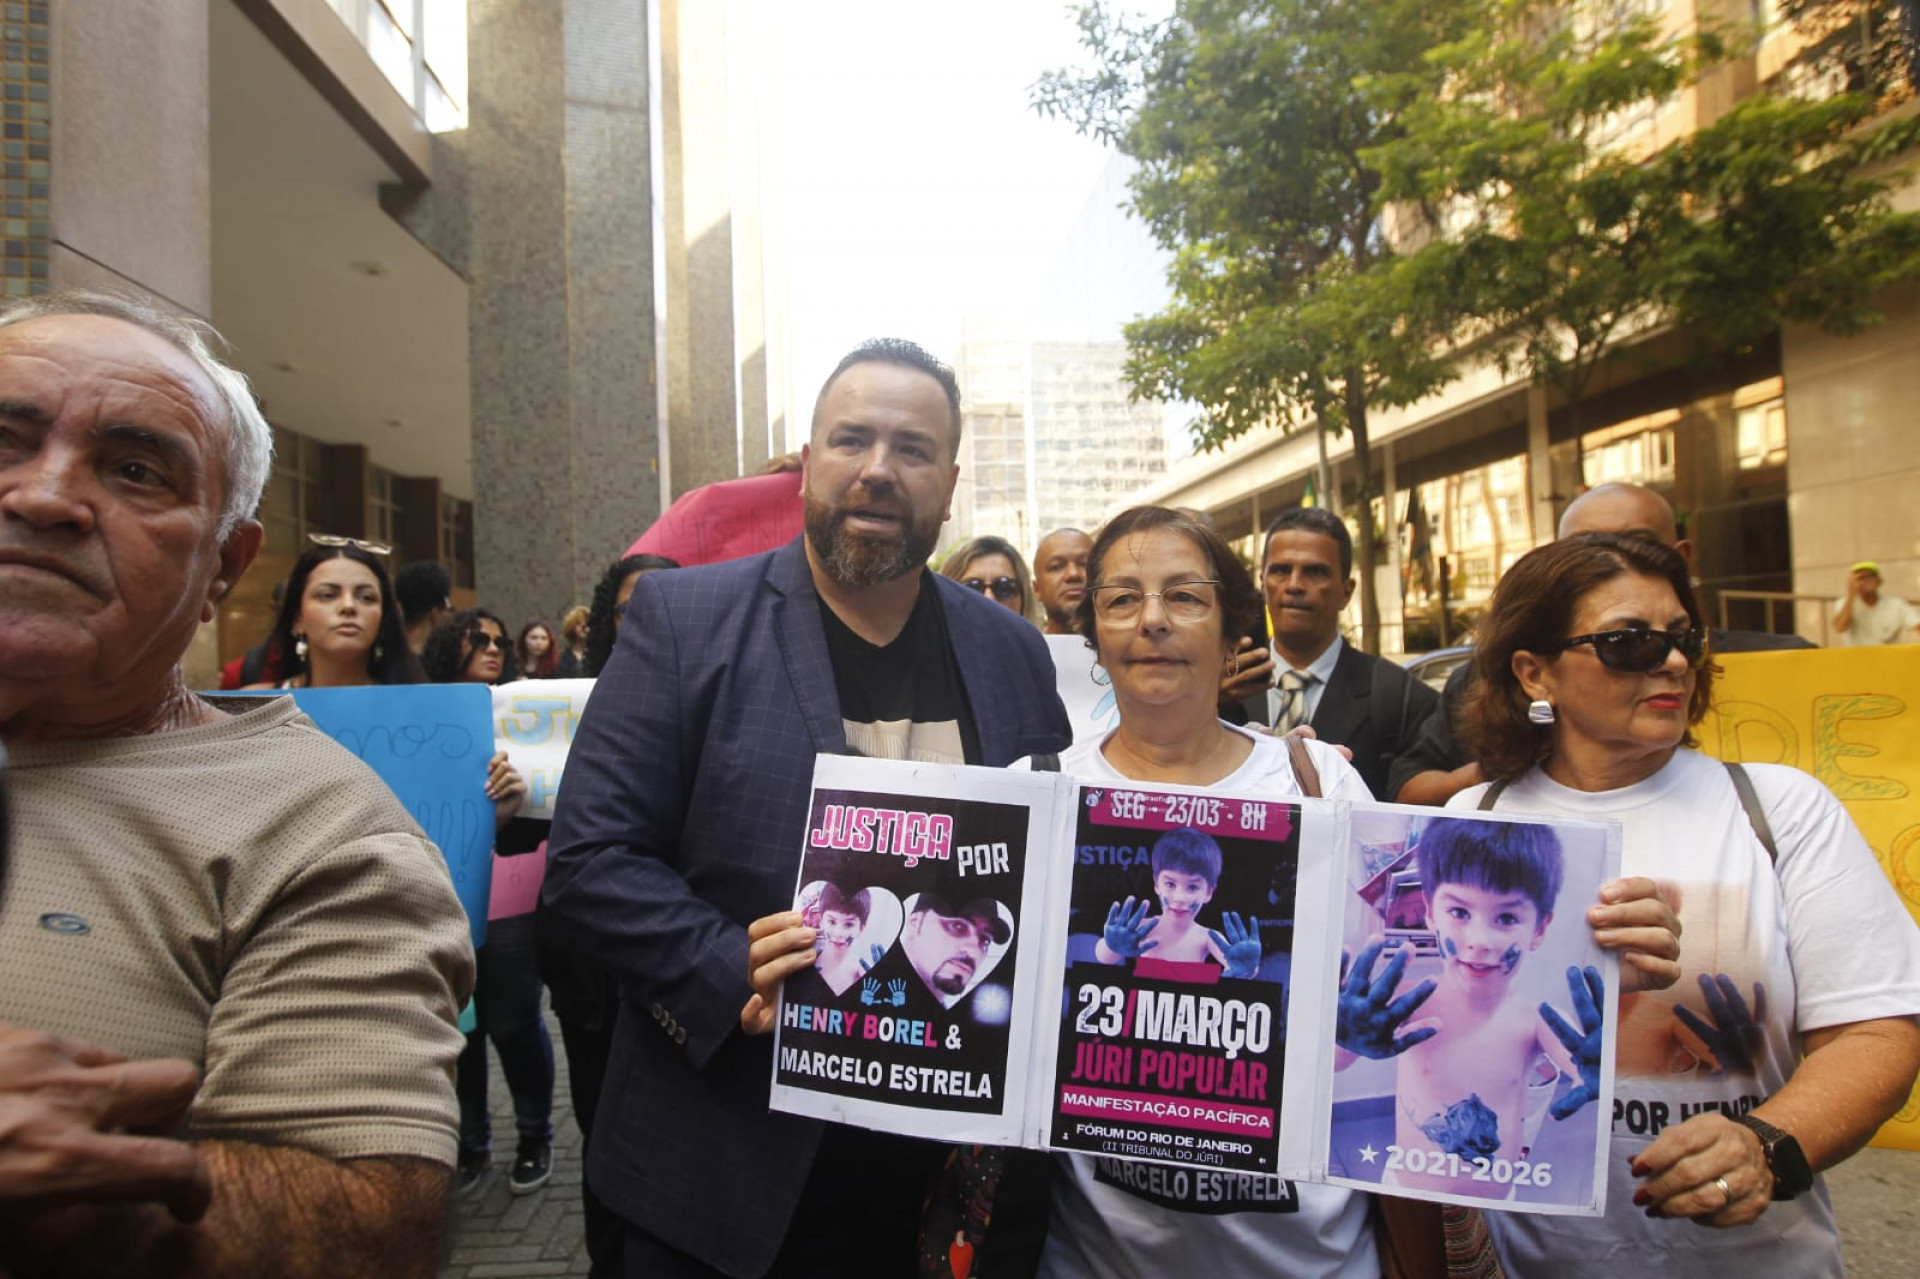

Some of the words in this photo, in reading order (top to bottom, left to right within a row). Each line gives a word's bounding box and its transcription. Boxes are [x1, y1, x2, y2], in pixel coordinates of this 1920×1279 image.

[1111, 791, 1145, 819] SEG
[1165, 796, 1220, 827] 23/03
[1240, 802, 1266, 831] 8H
[811, 805, 954, 868] JUSTIÇA
[956, 843, 1010, 877] POR
[783, 1002, 859, 1037] HENRY
[863, 1014, 938, 1049] BOREL
[944, 1025, 962, 1050] &
[781, 1046, 882, 1087] MARCELO
[889, 1064, 993, 1099] ESTRELA
[1071, 1037, 1132, 1084] JÚRI
[1139, 1049, 1268, 1101] POPULAR
[1063, 1092, 1190, 1119] MANIFESTAÇÃO
[1193, 1106, 1271, 1129] PACÍFICA
[1612, 1098, 1669, 1135] POR
[1076, 1123, 1124, 1140] FÓRUM
[1126, 1130, 1147, 1142] DO
[1149, 1132, 1173, 1145] RIO
[1175, 1136, 1194, 1148] DE
[1195, 1138, 1253, 1154] JANEIRO
[1120, 1143, 1174, 1158] TRIBUNAL
[1176, 1150, 1193, 1161] DO
[1195, 1151, 1224, 1166] JÚRI)
[1386, 1144, 1552, 1188] 2021-2026
[1196, 1171, 1290, 1202] ESTRELA
